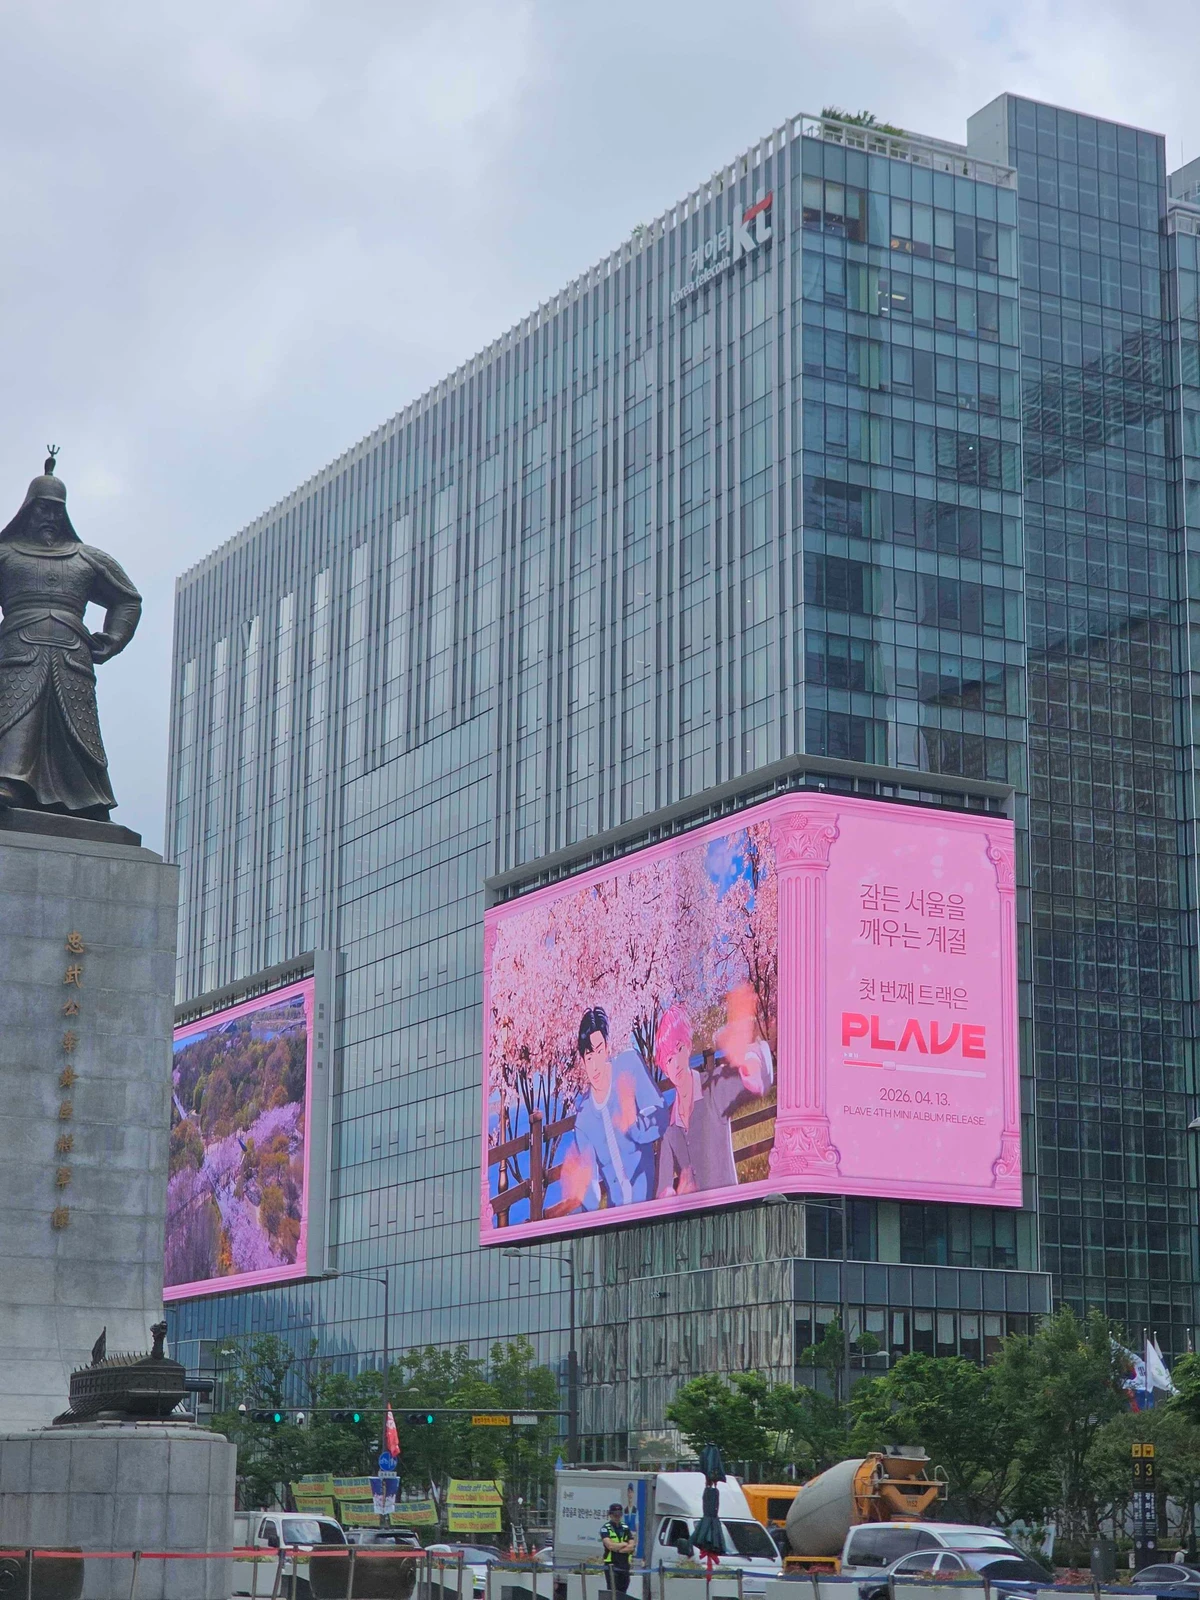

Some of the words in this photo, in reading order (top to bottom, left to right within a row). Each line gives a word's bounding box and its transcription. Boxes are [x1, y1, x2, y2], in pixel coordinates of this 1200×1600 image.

[733, 187, 773, 265] kt
[691, 225, 731, 272] 케이티
[860, 884, 900, 913] 잠든
[905, 890, 966, 921] 서울을
[860, 919, 922, 950] 깨우는
[926, 926, 967, 955] 계절
[859, 978, 875, 1001] 첫
[880, 981, 914, 1005] 번째
[918, 984, 968, 1010] 트랙은
[841, 1012, 987, 1060] PLAVE
[880, 1087, 912, 1103] 2026.
[914, 1090, 933, 1105] 04.
[935, 1092, 951, 1106] 13.
[843, 1105, 872, 1116] PLAVE
[873, 1108, 892, 1118] 4TH
[893, 1109, 912, 1119] MINI
[913, 1111, 945, 1122] ALBUM
[945, 1113, 987, 1126] RELEASE.
[1134, 1463, 1140, 1476] 3
[1145, 1463, 1153, 1476] 3
